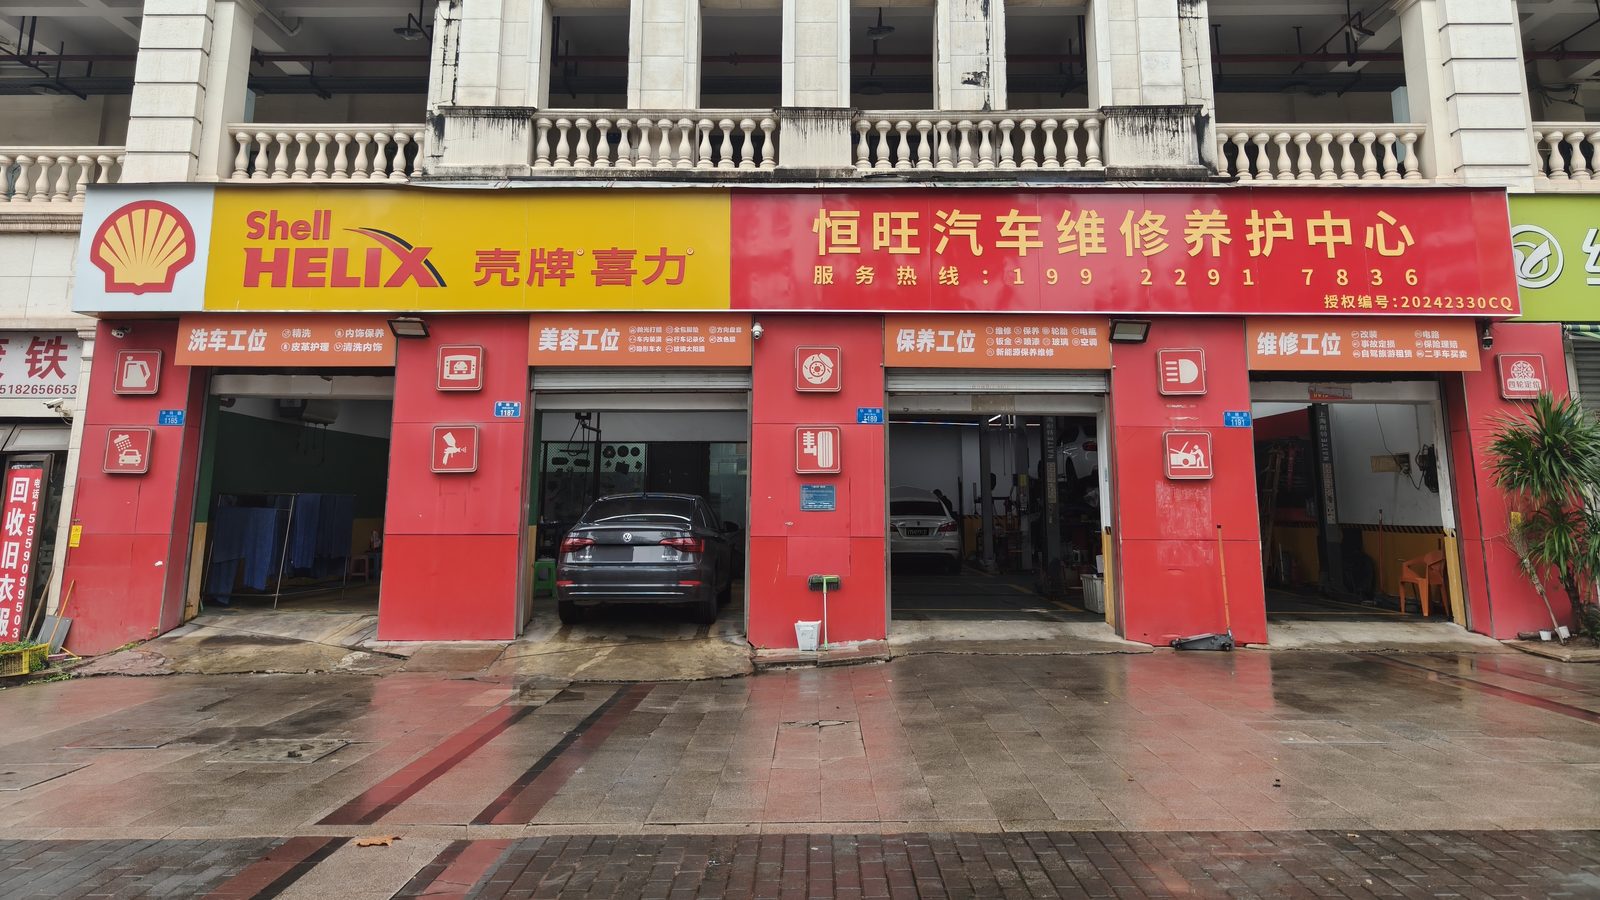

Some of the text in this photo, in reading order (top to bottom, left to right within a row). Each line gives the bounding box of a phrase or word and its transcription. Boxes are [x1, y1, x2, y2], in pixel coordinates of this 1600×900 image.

[247, 209, 332, 240] Shell
[812, 208, 1416, 259] 恒旺汽车维修养护中心
[243, 247, 440, 288] HELIX
[187, 328, 268, 352] 洗车工位
[291, 328, 312, 338] 精洗
[345, 328, 385, 338] 内饰保养
[538, 327, 621, 351] 美容工位
[896, 328, 976, 353] 保养工位
[1023, 327, 1040, 335] 保养
[1051, 327, 1068, 336] 轮胎
[291, 342, 330, 352] 皮革护理
[342, 342, 383, 352] 清洗内饰
[1256, 331, 1342, 356] 维修工位
